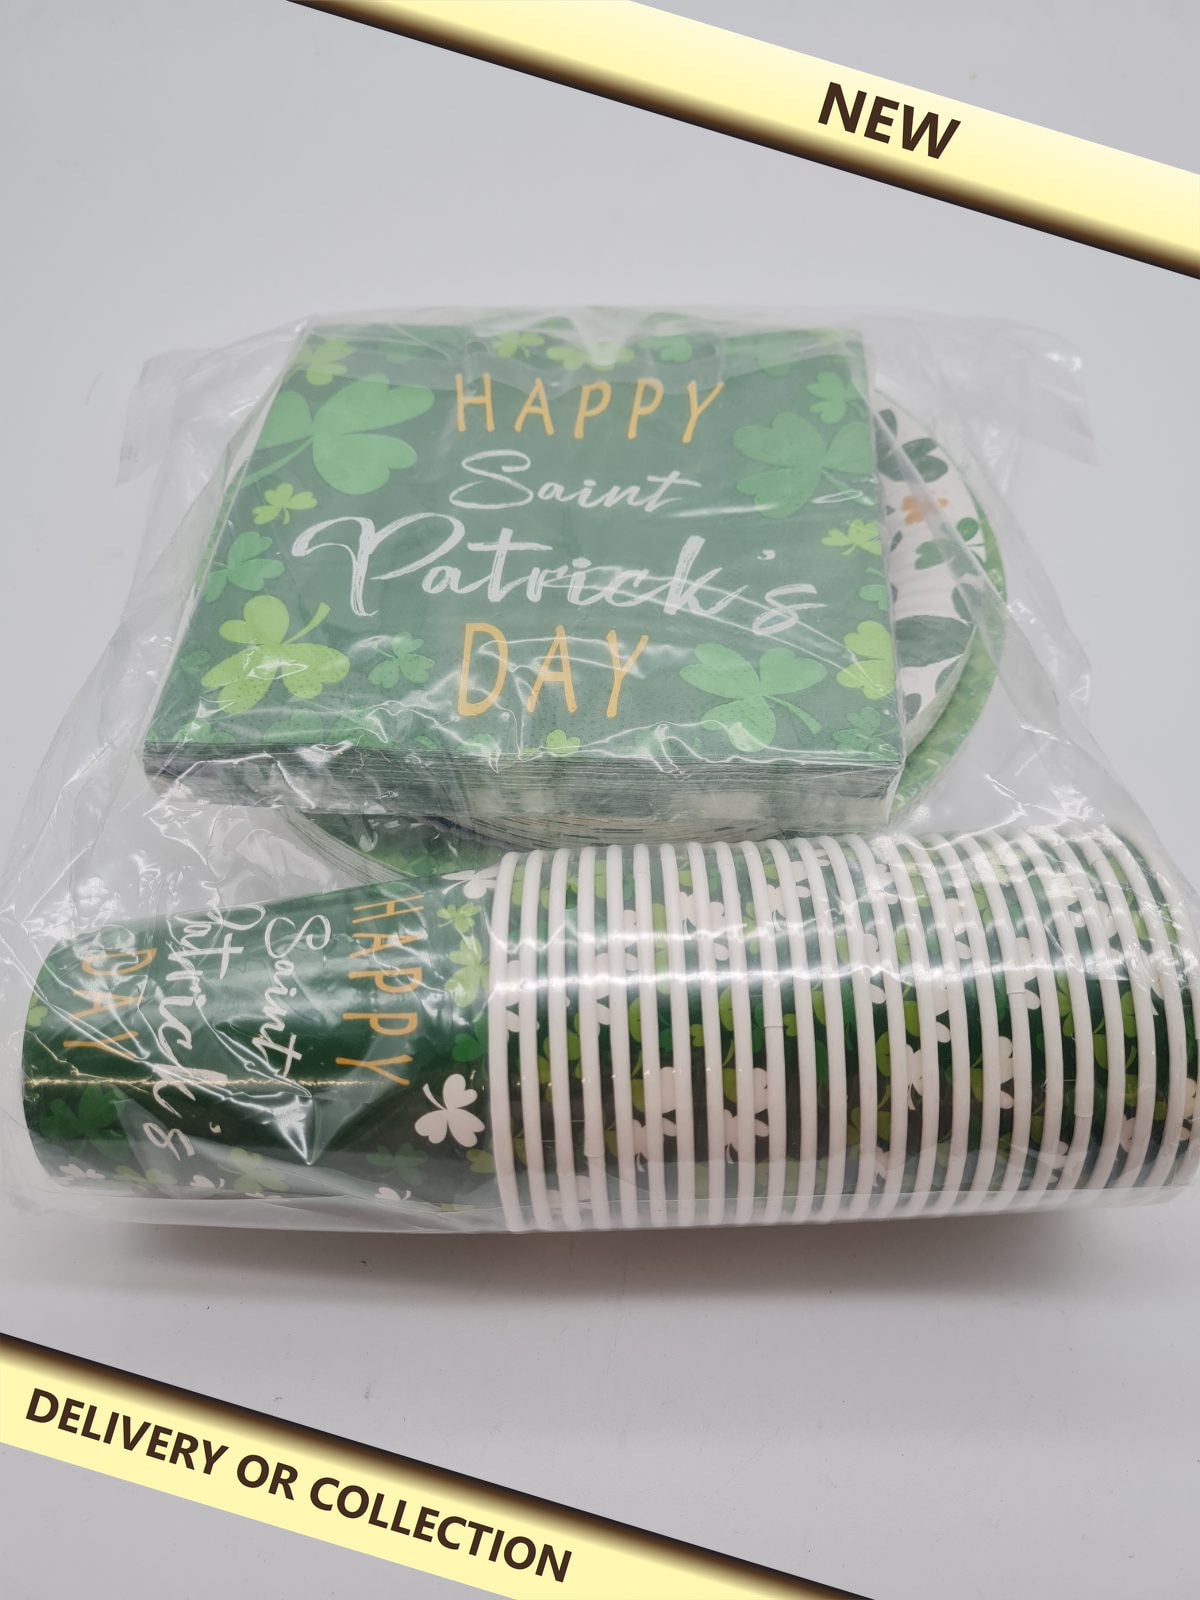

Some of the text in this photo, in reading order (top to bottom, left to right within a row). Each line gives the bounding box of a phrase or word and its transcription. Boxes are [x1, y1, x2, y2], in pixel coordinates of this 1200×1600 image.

[455, 373, 724, 442] HAPPY
[449, 450, 702, 512] Saint
[291, 513, 825, 635] Patrick's
[456, 624, 649, 718] DAY
[64, 948, 157, 1060] DAY
[251, 914, 332, 1077] Saint
[335, 895, 424, 1086] HAPPY
